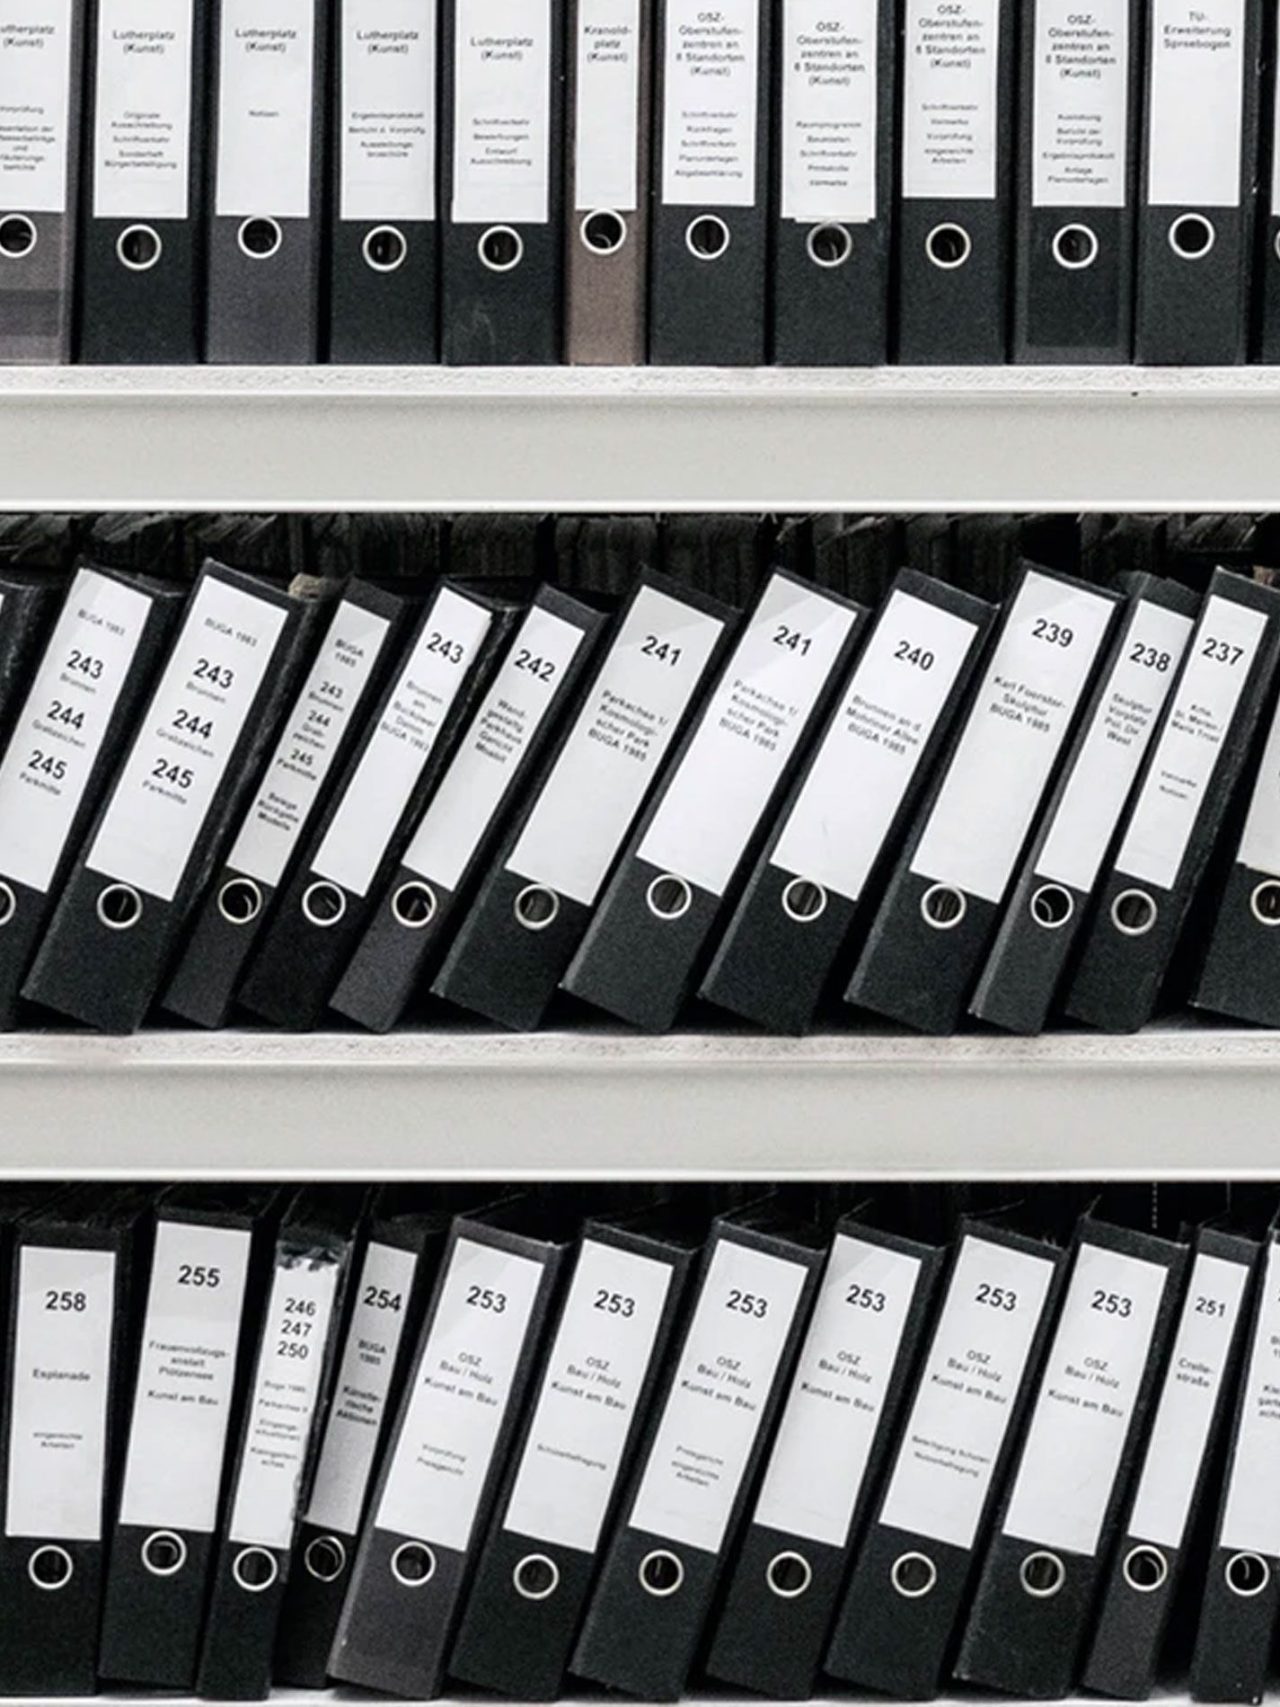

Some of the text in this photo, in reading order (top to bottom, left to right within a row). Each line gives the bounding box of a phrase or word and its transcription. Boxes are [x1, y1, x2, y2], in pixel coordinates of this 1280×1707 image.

[1163, 24, 1231, 37] Erweiterung
[425, 631, 464, 664] 243
[772, 624, 812, 657] 241
[1031, 617, 1074, 648] 239
[65, 649, 104, 680] 243
[640, 634, 682, 666] 241
[892, 639, 935, 671] 240
[1128, 641, 1171, 673] 238
[1201, 636, 1245, 666] 237
[192, 657, 234, 689] 243
[513, 648, 556, 683] 242
[319, 680, 343, 699] 243
[46, 699, 85, 730] 244
[171, 708, 213, 740] 244
[307, 709, 331, 727] 244
[989, 702, 1022, 722] BUGA
[587, 727, 619, 749] BUGA
[847, 722, 879, 743] BUGA
[27, 749, 68, 780] 245
[290, 748, 314, 766] 245
[150, 757, 194, 789] 245
[176, 1263, 220, 1288] 255
[44, 1290, 87, 1313] 258
[283, 1297, 316, 1317] 246
[362, 1285, 402, 1313] 254
[465, 1284, 507, 1314] 253
[592, 1288, 635, 1318] 253
[725, 1288, 768, 1319] 253
[845, 1283, 886, 1313] 253
[974, 1282, 1017, 1312] 253
[1090, 1289, 1132, 1318] 253
[1194, 1295, 1226, 1317] 251
[280, 1318, 312, 1337] 247
[276, 1340, 309, 1360] 250
[32, 1368, 91, 1381] Esplanade
